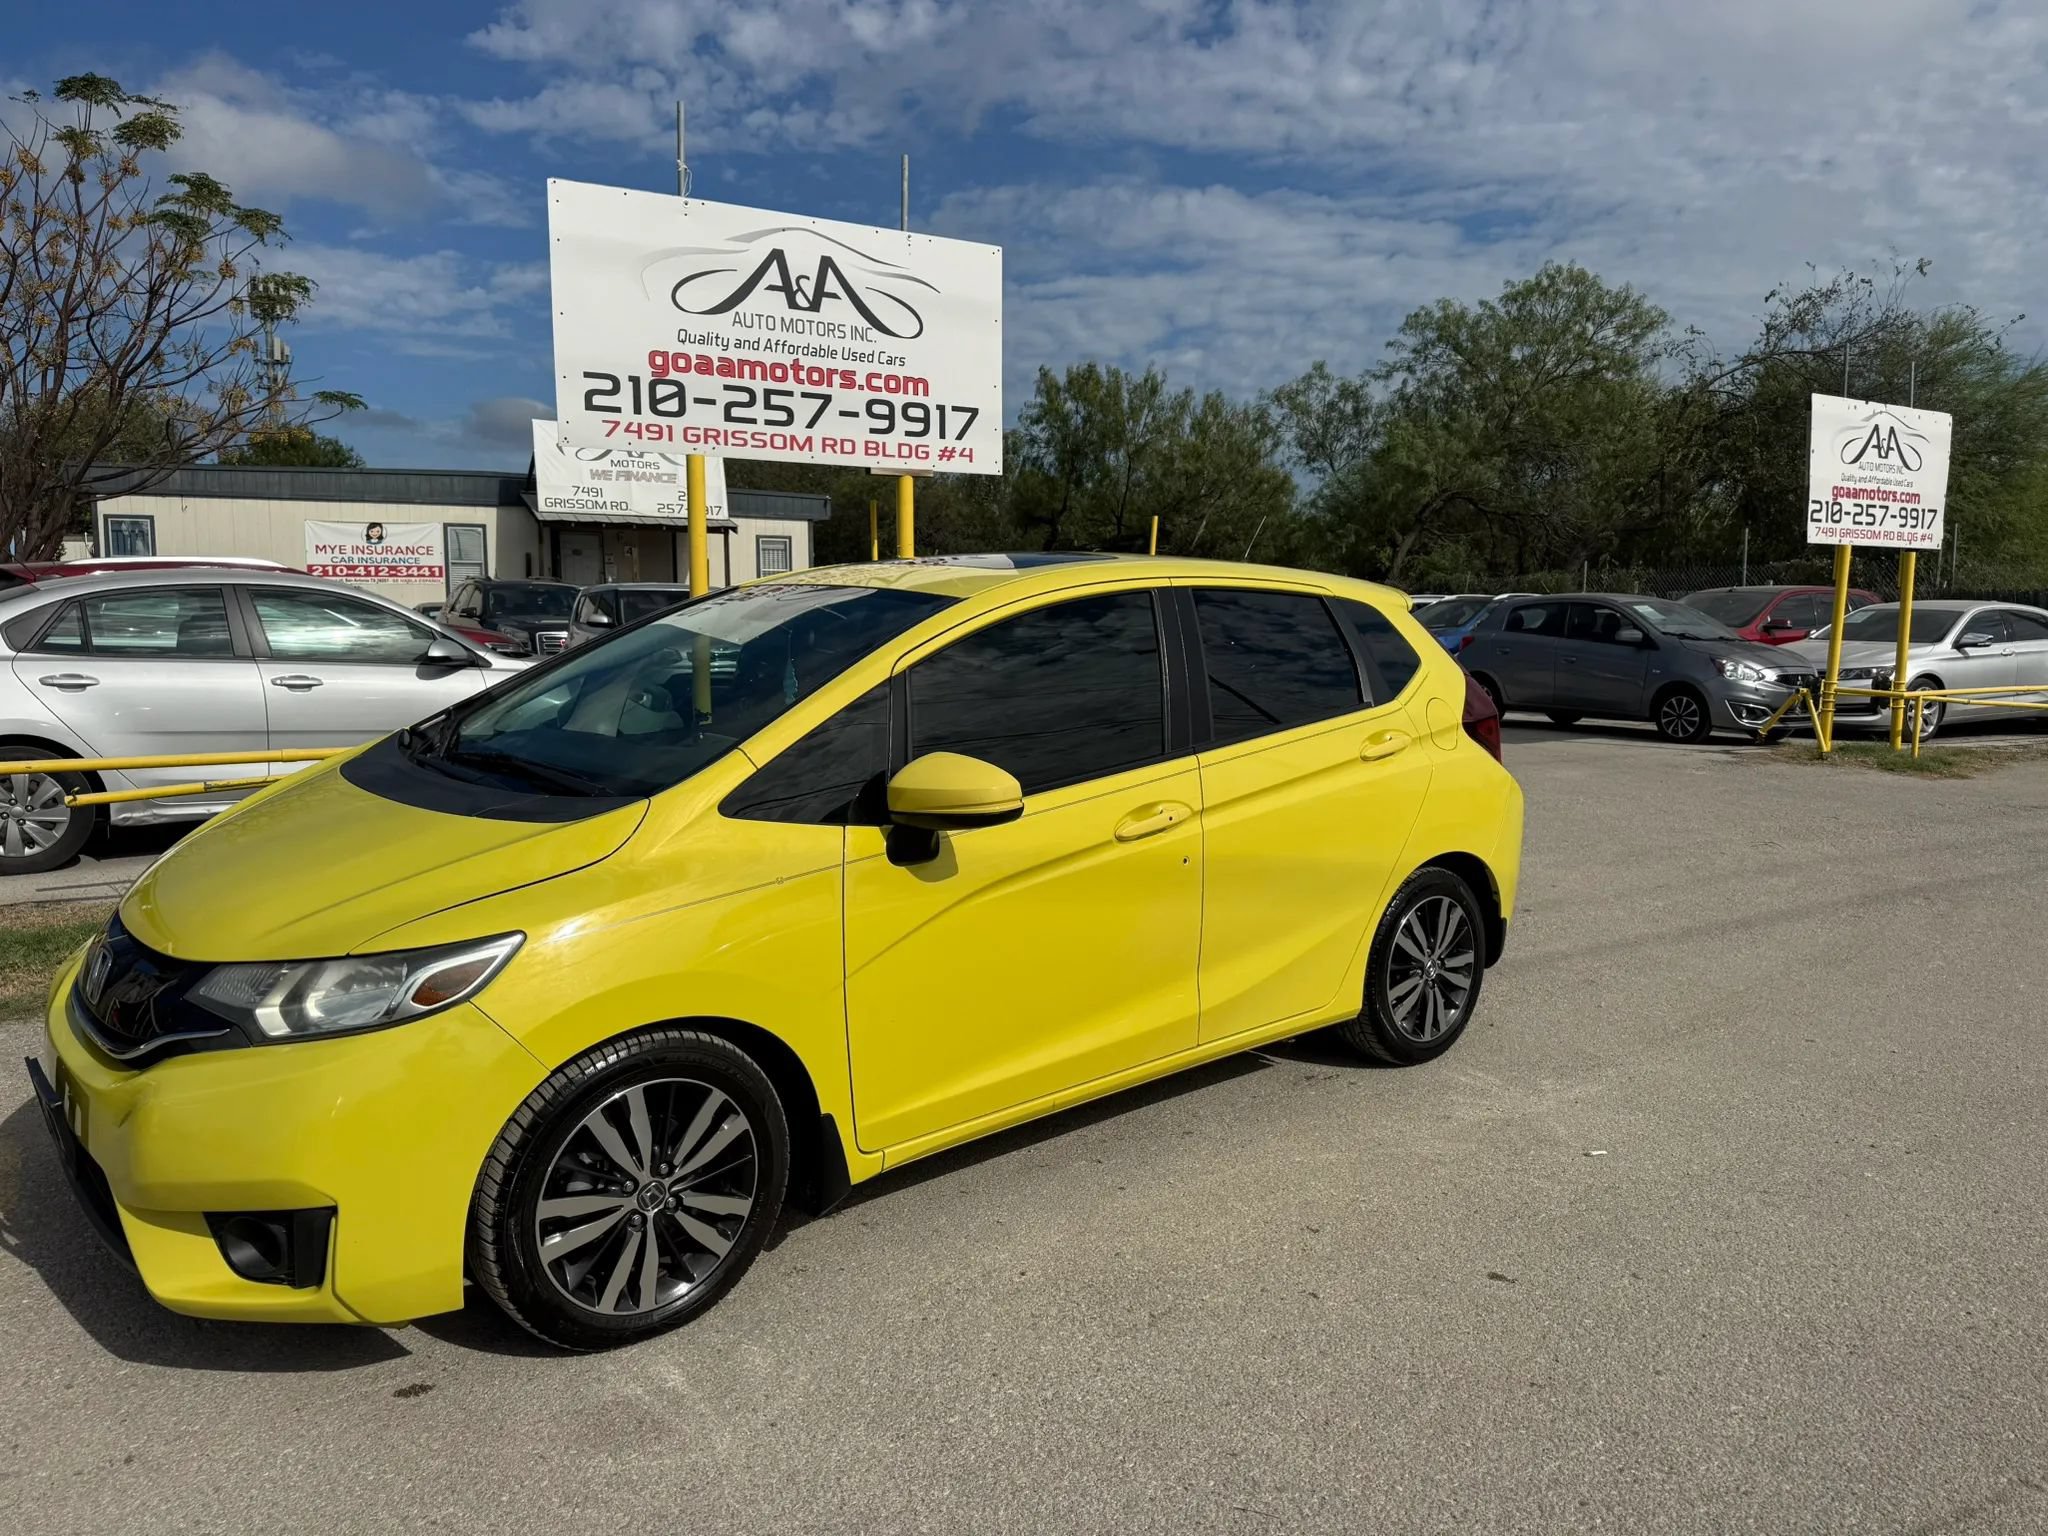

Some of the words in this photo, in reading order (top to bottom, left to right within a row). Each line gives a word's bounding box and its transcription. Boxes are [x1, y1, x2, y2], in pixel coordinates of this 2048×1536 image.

[671, 248, 923, 339] A&A
[732, 311, 776, 332] AUTO
[780, 317, 848, 341] MOTORS
[850, 325, 877, 343] INC.
[677, 328, 729, 352] Quality
[734, 335, 760, 351] and
[763, 337, 838, 358] Affordable
[841, 346, 875, 363] Used
[877, 350, 906, 367] Cars
[648, 349, 930, 397] goaamotors.com
[582, 371, 979, 441] 210-257-9917
[601, 419, 675, 443] 7491
[682, 426, 815, 453] GRISSOM
[821, 436, 856, 455] RD
[863, 441, 930, 460] BLDG
[937, 446, 974, 463] #4
[1841, 424, 1922, 471] A&A
[610, 459, 660, 470] MOTORS
[1858, 461, 1874, 471] AUTO
[1875, 463, 1896, 474] MOTORS
[589, 468, 613, 481] WE
[615, 470, 677, 484] FINANCE
[1841, 472, 1857, 485] Quality
[1858, 474, 1868, 483] and
[571, 485, 603, 498] 7491
[1832, 485, 1920, 504] goaamotors.com
[545, 497, 607, 510] GRISSOM
[1810, 500, 1938, 530] 210-257-9917
[1815, 526, 1837, 537] 7491
[1839, 527, 1881, 540] GRISSOM
[1882, 530, 1895, 541] RD
[1919, 533, 1933, 543] #4
[315, 544, 347, 555] MYE
[351, 545, 434, 556] INSURANCE
[330, 556, 355, 564] CAR
[358, 557, 420, 565] INSURANCE
[311, 565, 440, 576] 210-412-3441
